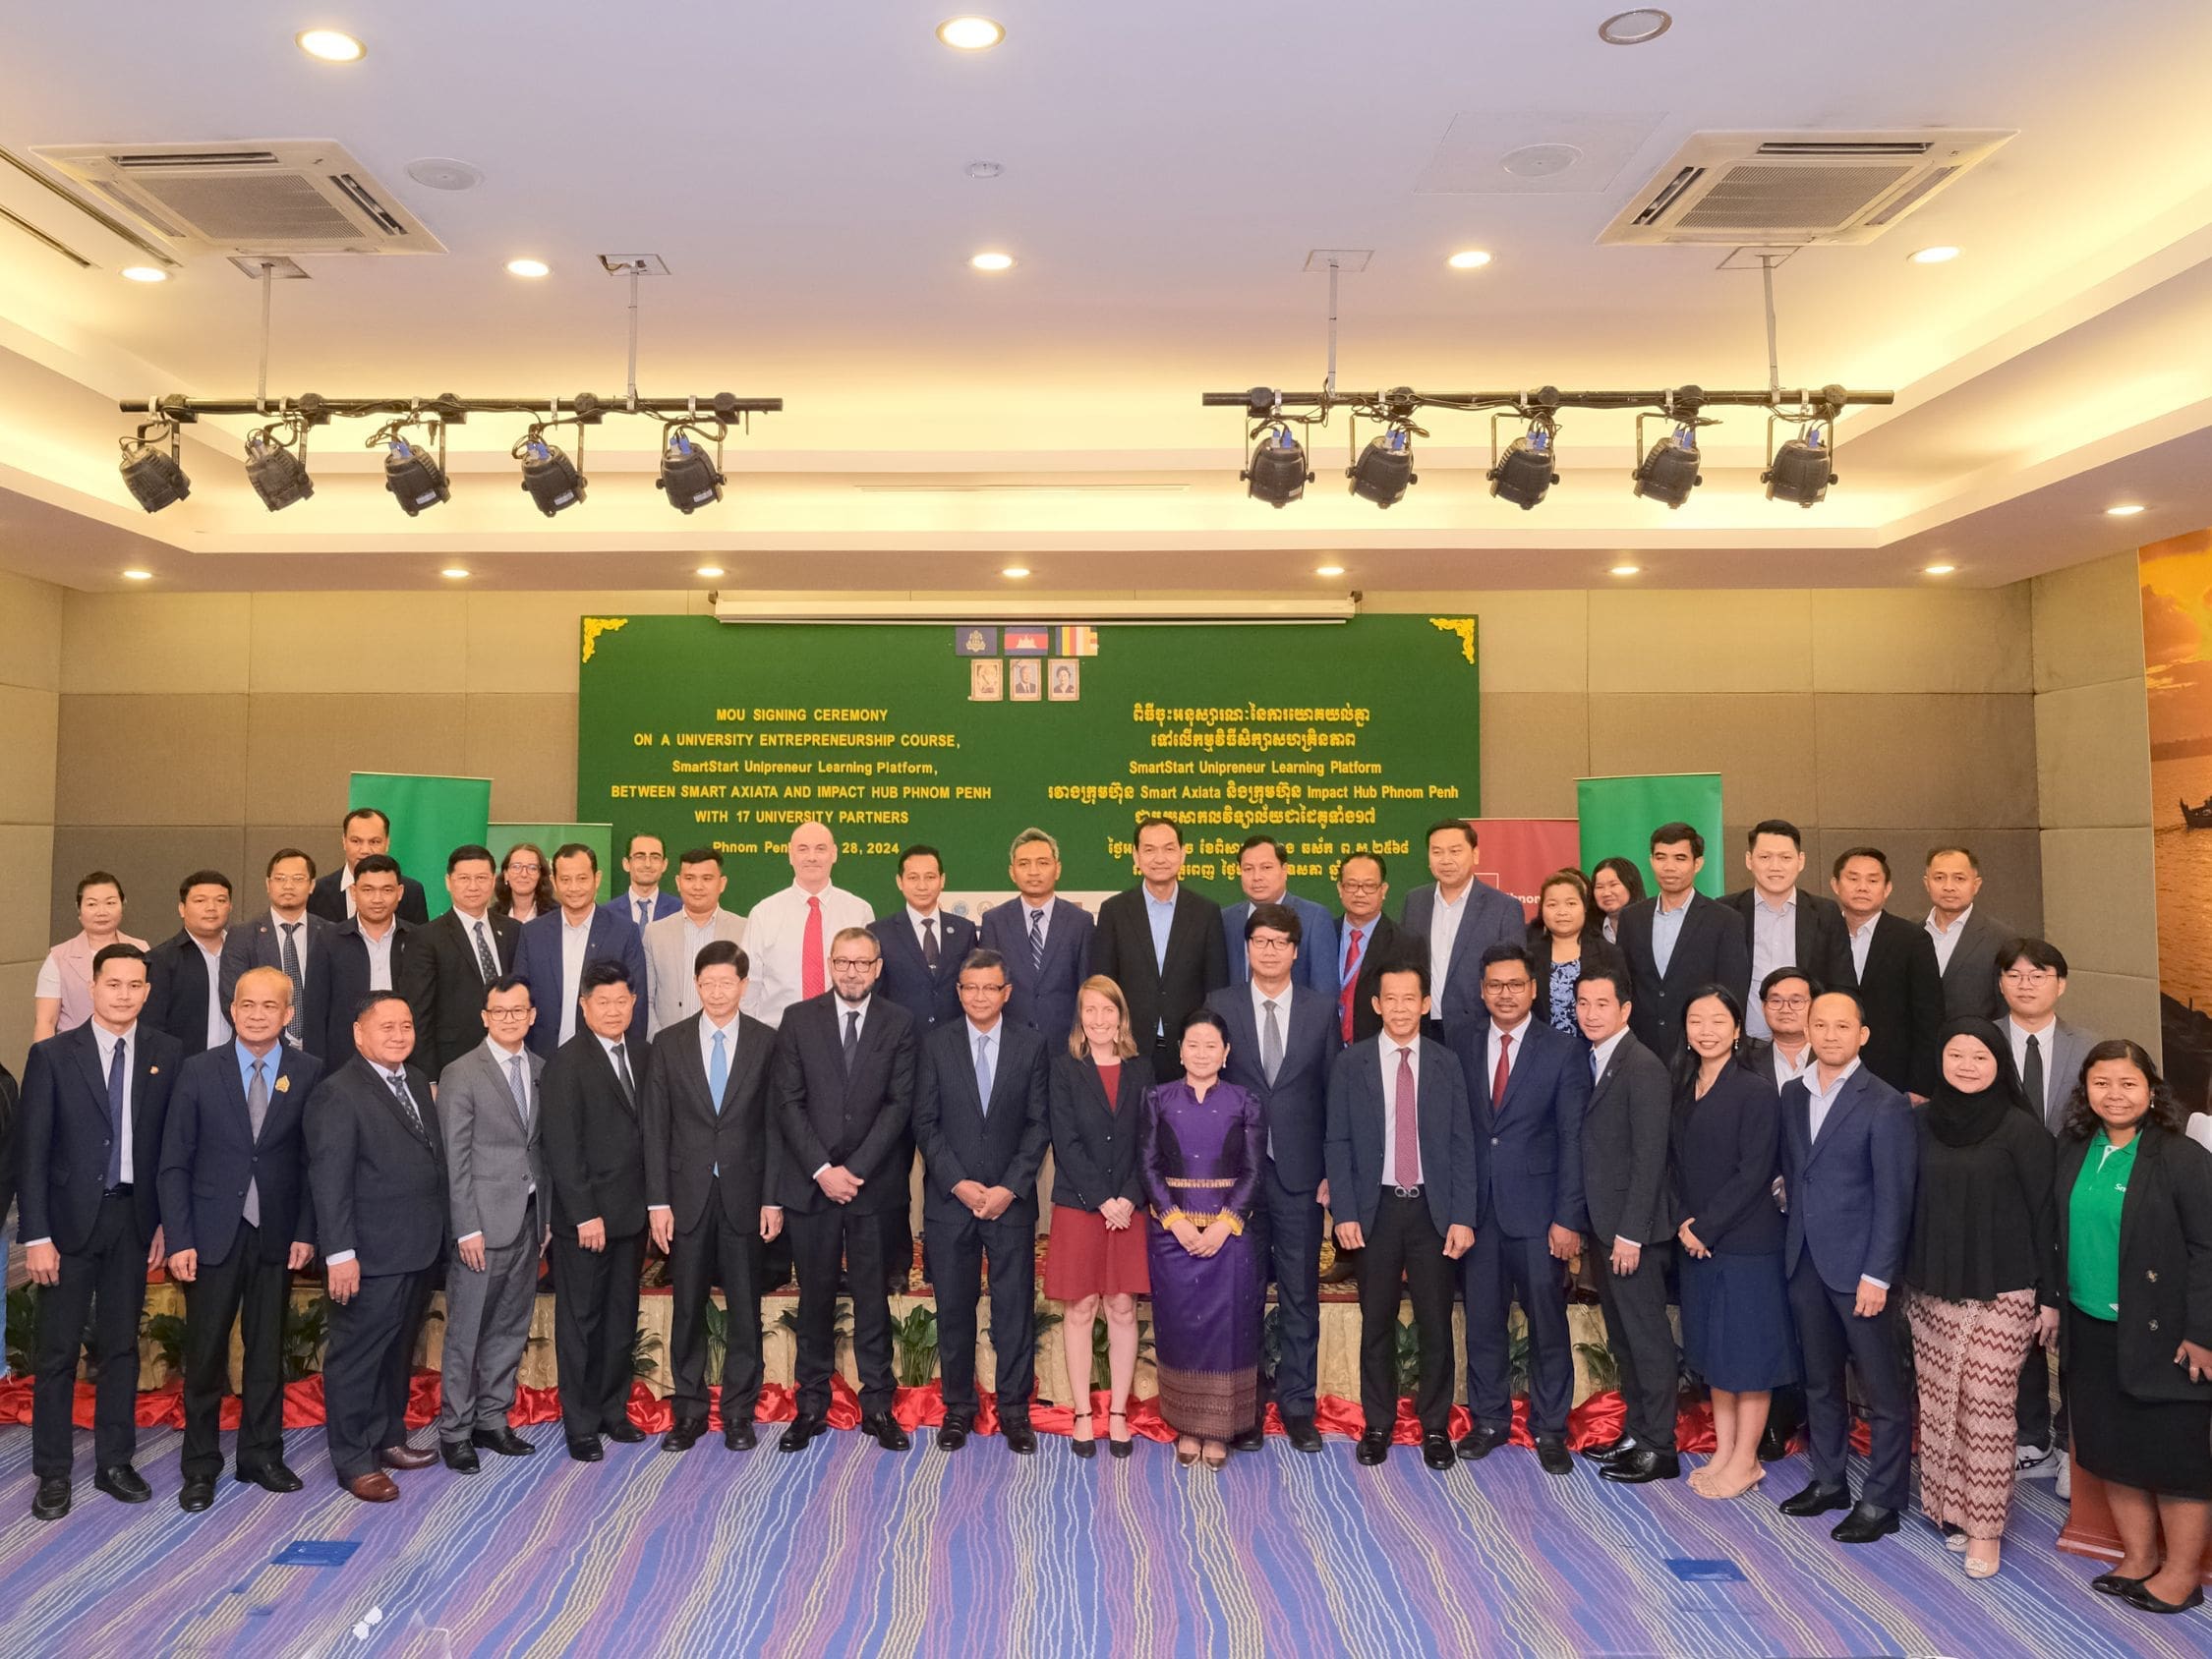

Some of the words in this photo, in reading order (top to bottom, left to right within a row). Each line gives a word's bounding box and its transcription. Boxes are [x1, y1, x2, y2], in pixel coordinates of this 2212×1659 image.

[716, 708, 746, 721] MOU
[752, 708, 807, 722] SIGNING
[813, 708, 889, 722] CEREMONY
[633, 733, 653, 746] ON
[661, 733, 670, 746] A
[676, 733, 754, 747] UNIVERSITY
[759, 733, 896, 747] ENTREPRENEURSHIP
[900, 733, 960, 748] COURSE,
[671, 760, 739, 774] SmartStart
[744, 760, 813, 776] Unipreneur
[817, 760, 873, 776] Learning
[876, 761, 938, 776] Platform,
[1129, 760, 1195, 774] SmartStart
[1198, 760, 1266, 776] Unipreneur
[1271, 760, 1325, 777] Learning
[1330, 760, 1382, 774] Platform
[611, 784, 676, 798] BETWEEN
[680, 784, 728, 798] SMART
[730, 785, 779, 798] AXIATA
[783, 785, 812, 799] AND
[817, 785, 866, 799] IMPACT
[871, 785, 899, 799] HUB
[902, 785, 951, 799] PHNOM
[956, 785, 992, 799] PENH
[1139, 784, 1178, 799] Smart
[1181, 785, 1222, 799] Axiata
[1307, 785, 1349, 802] Impact
[1353, 785, 1378, 799] Hub
[1381, 784, 1425, 799] Phnom
[1427, 784, 1459, 799] Penh
[694, 810, 728, 823] WITH
[736, 810, 751, 823] 17
[755, 810, 834, 824] UNIVERSITY
[839, 810, 909, 824] PARTNERS
[712, 840, 758, 854] Phnom
[764, 840, 790, 853] Pen
[842, 841, 863, 856] 28,
[866, 841, 901, 855] 2024
